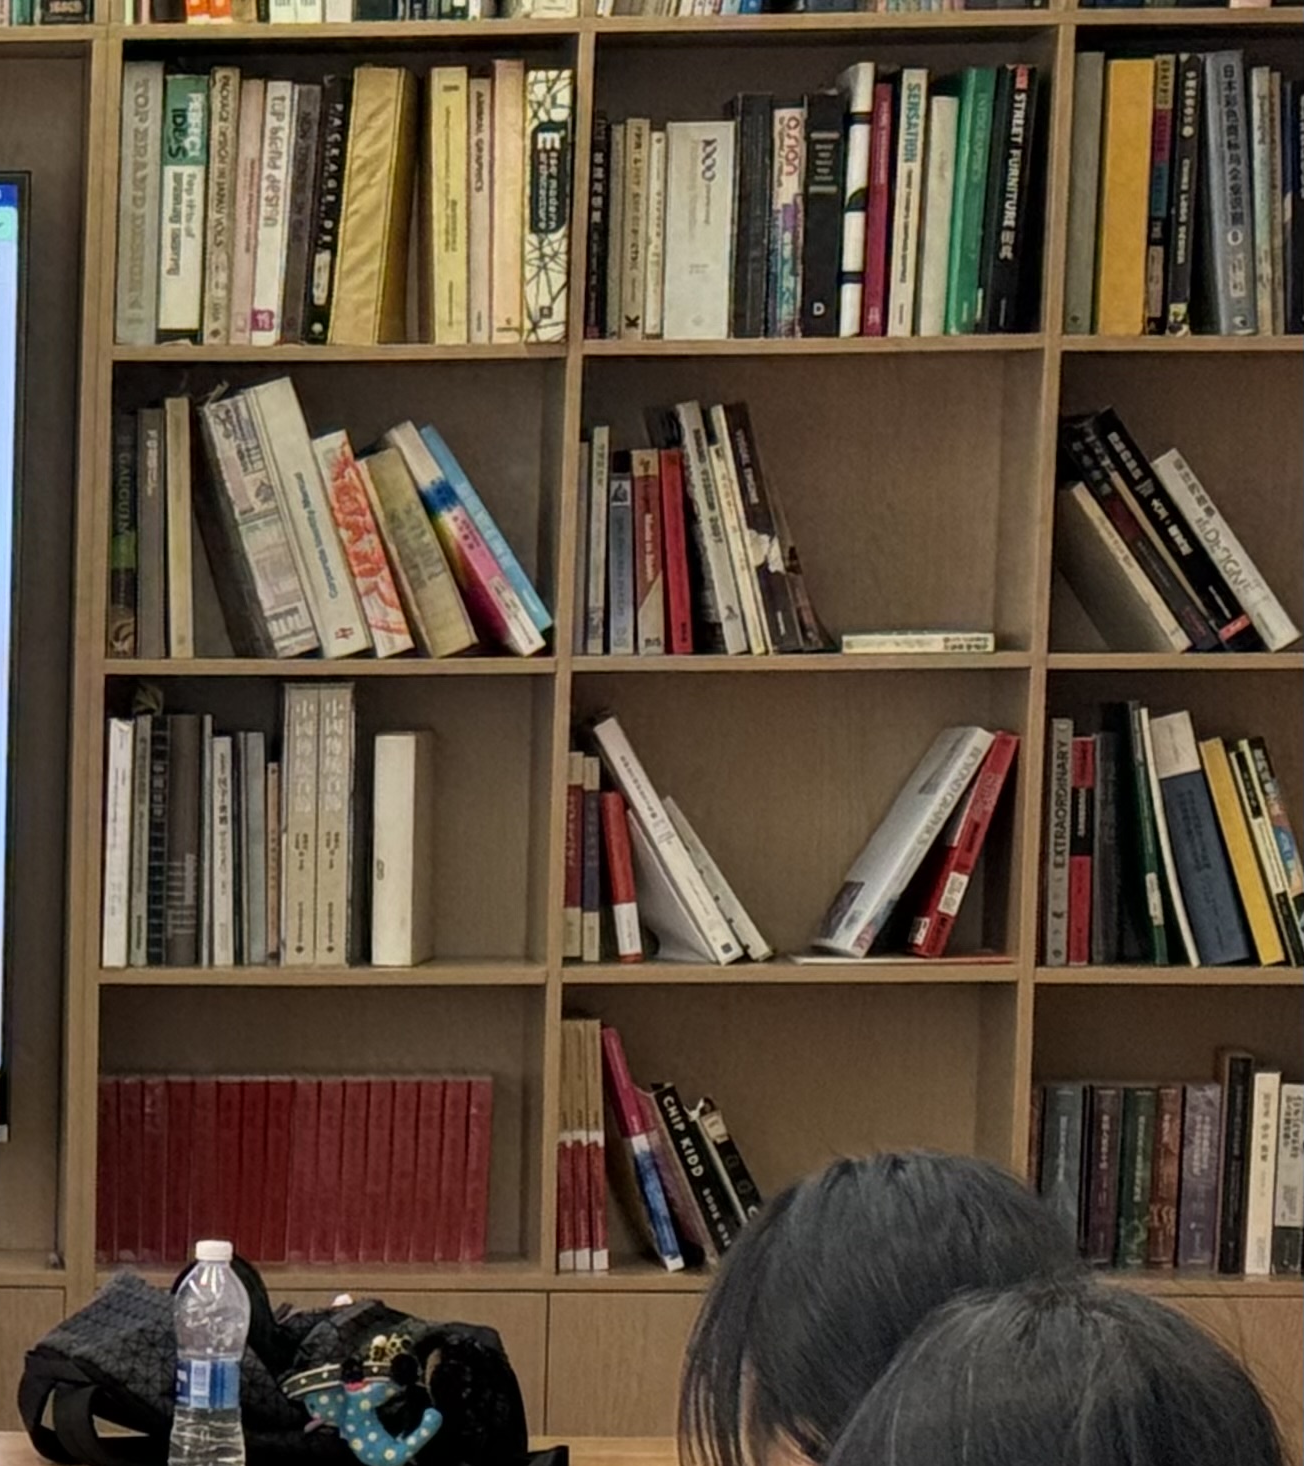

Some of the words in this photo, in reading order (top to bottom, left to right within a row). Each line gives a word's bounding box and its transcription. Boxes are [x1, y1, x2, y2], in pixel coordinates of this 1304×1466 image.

[132, 78, 151, 124] TOP
[903, 82, 922, 163] SENSATION
[1011, 92, 1028, 143] STREET
[1003, 149, 1023, 229] FURNITURE
[1054, 740, 1071, 870] EXTRAORDINARY
[661, 1093, 687, 1137] CHIP
[678, 1135, 706, 1178] KIDD
